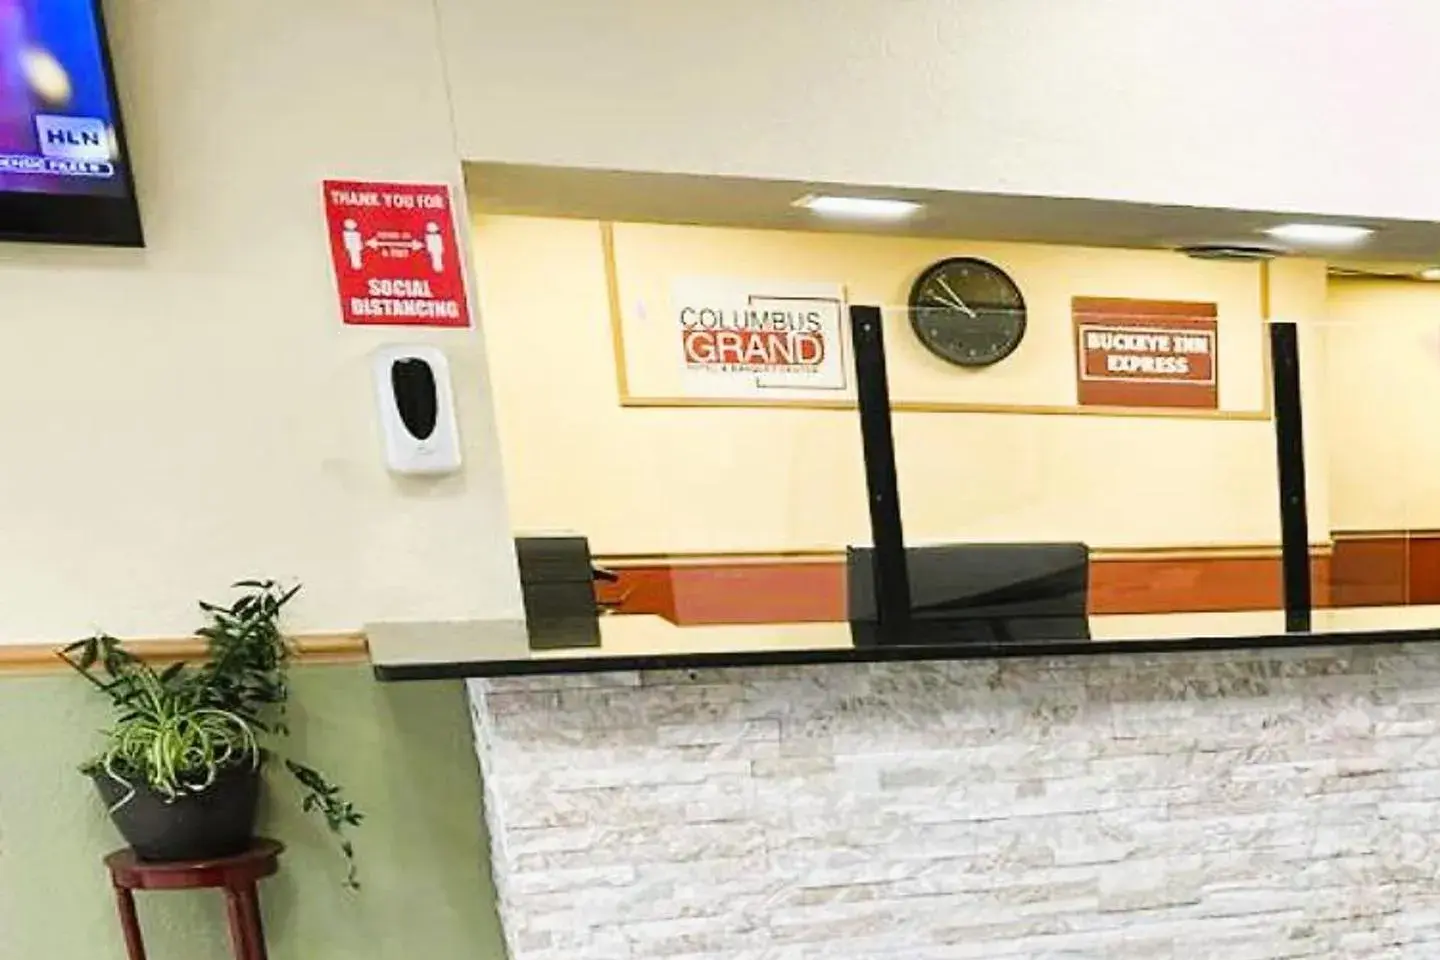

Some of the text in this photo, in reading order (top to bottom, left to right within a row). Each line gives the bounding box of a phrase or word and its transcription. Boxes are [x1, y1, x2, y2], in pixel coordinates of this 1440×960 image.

[47, 129, 99, 146] HLN
[331, 190, 444, 209] THANK YOU FOR
[368, 279, 433, 297] SOCIAL
[351, 298, 460, 318] DISTANCING
[681, 307, 821, 331] COLUMBUS
[685, 331, 825, 365] GRAND
[1173, 336, 1209, 354] INN
[1107, 355, 1188, 372] EXPRESS
